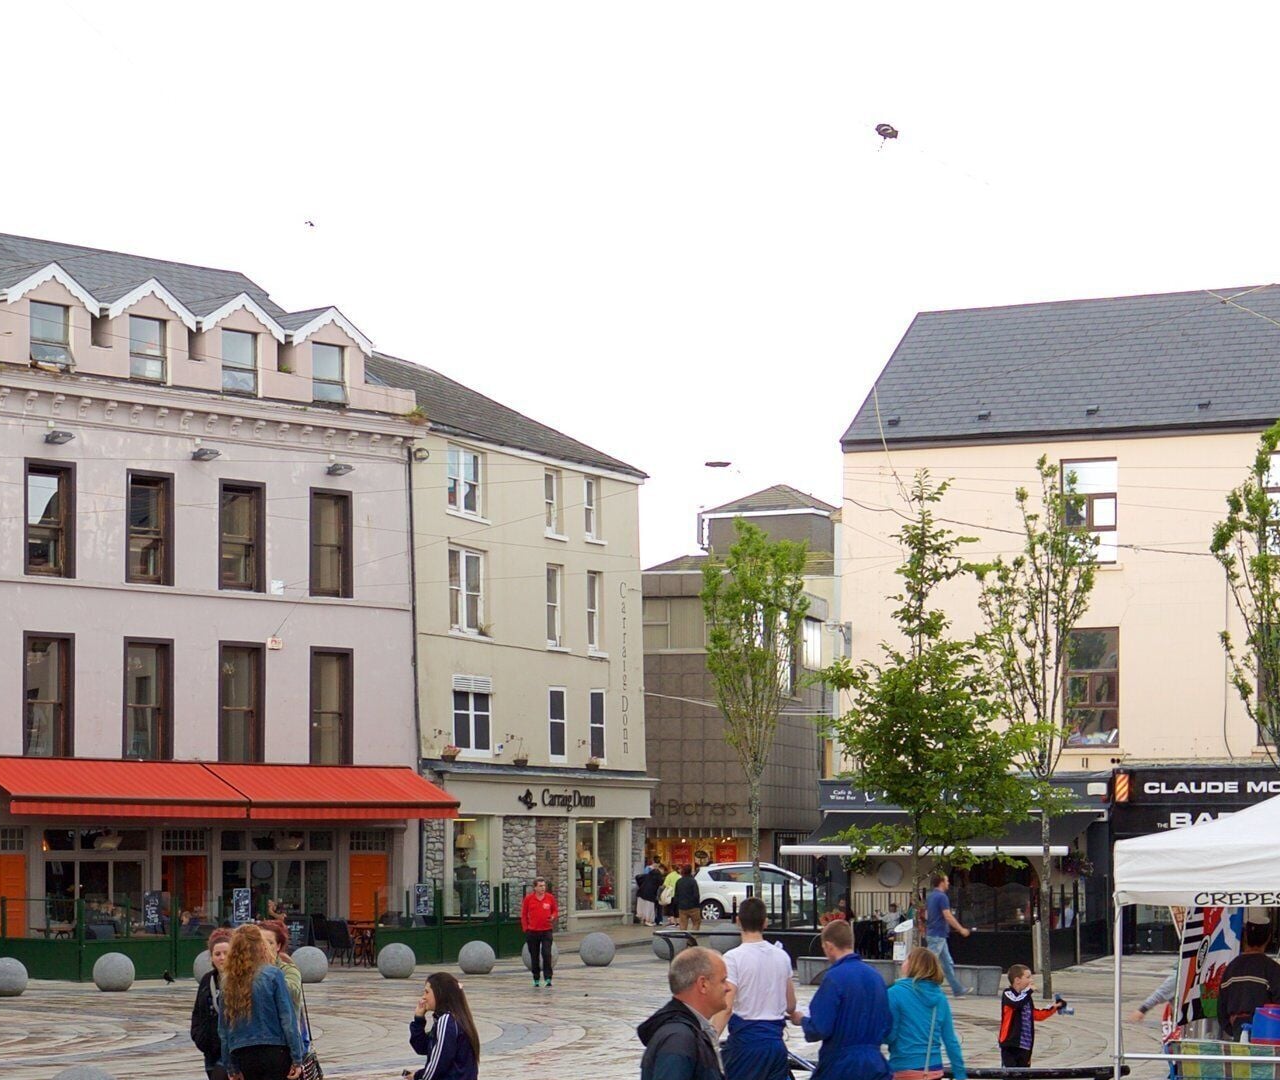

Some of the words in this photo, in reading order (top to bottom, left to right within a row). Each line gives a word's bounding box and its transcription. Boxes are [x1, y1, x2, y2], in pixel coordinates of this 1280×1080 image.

[620, 580, 628, 690] Carraig
[1143, 782, 1239, 794] CLAUDE
[541, 788, 573, 812] Carraig
[573, 790, 596, 808] Donn
[668, 799, 737, 816] Brothers
